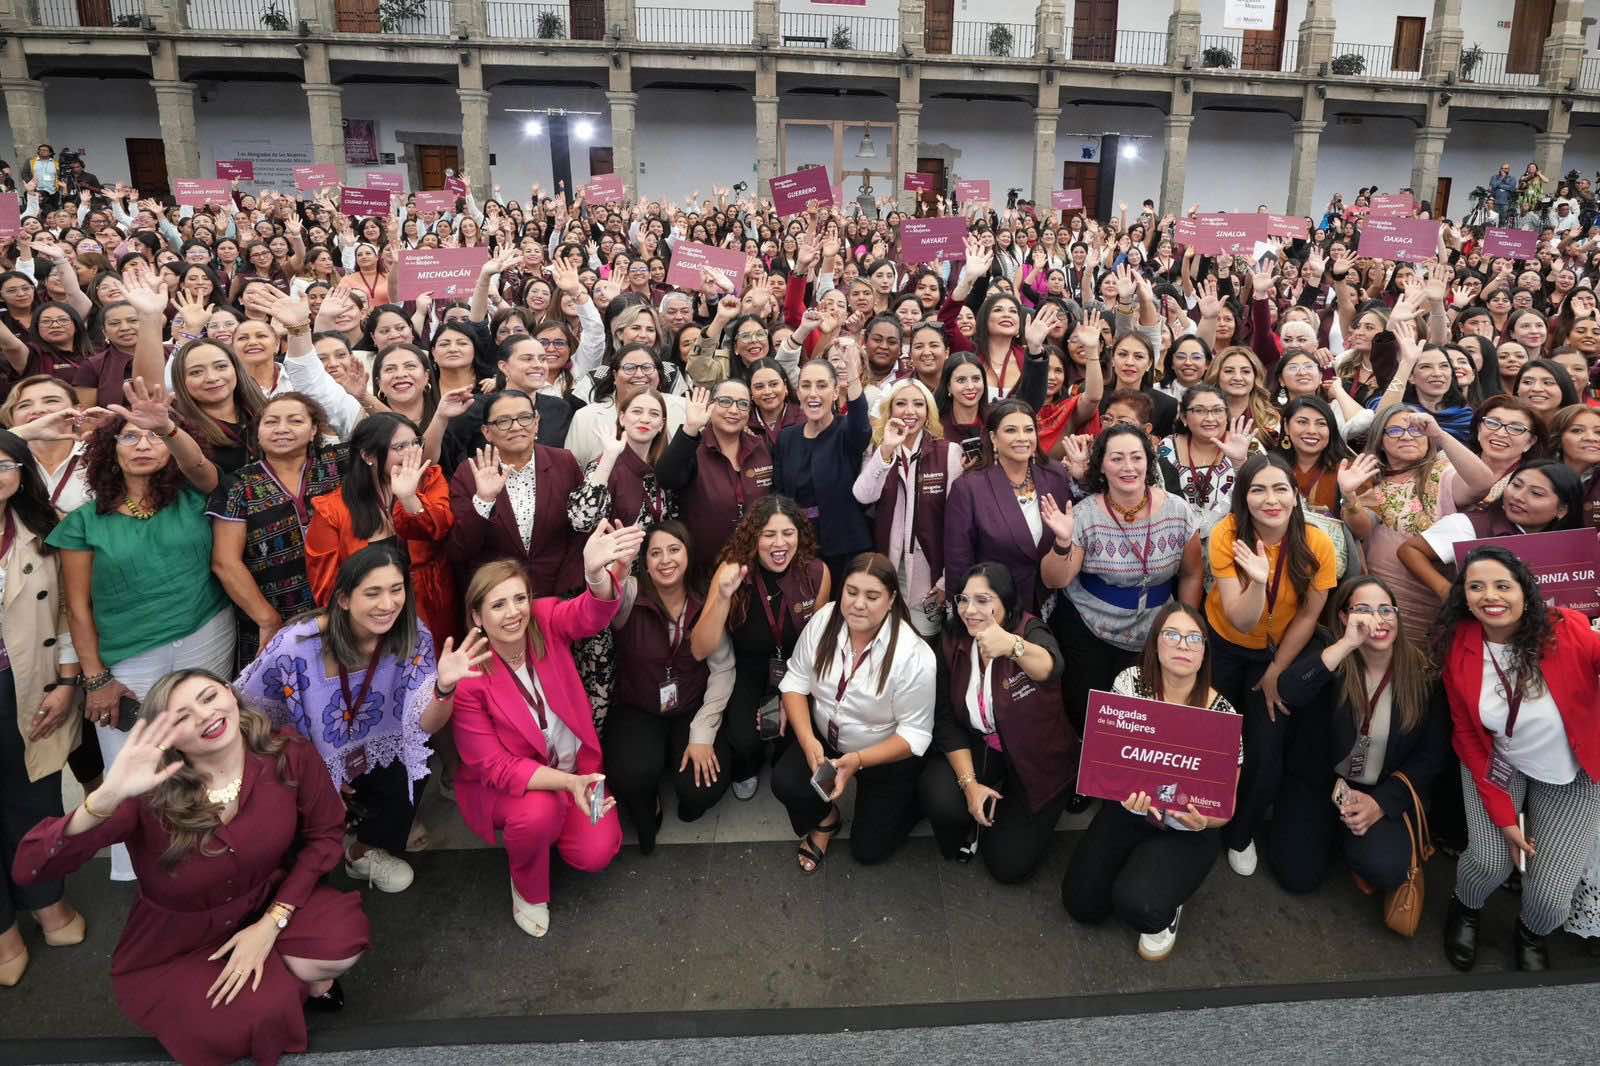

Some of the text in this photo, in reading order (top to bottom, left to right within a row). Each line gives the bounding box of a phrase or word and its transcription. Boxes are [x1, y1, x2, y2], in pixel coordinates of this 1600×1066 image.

[787, 186, 817, 199] GUERRERO
[921, 236, 948, 244] NAYARIT
[1383, 235, 1413, 244] OAXACA
[416, 268, 472, 280] MICHOACÁN
[1572, 569, 1595, 581] SUR
[1098, 704, 1147, 721] Abogadas
[1116, 719, 1156, 734] Mujeres
[1120, 745, 1202, 771] CAMPECHE
[1189, 795, 1221, 807] Mujeres
